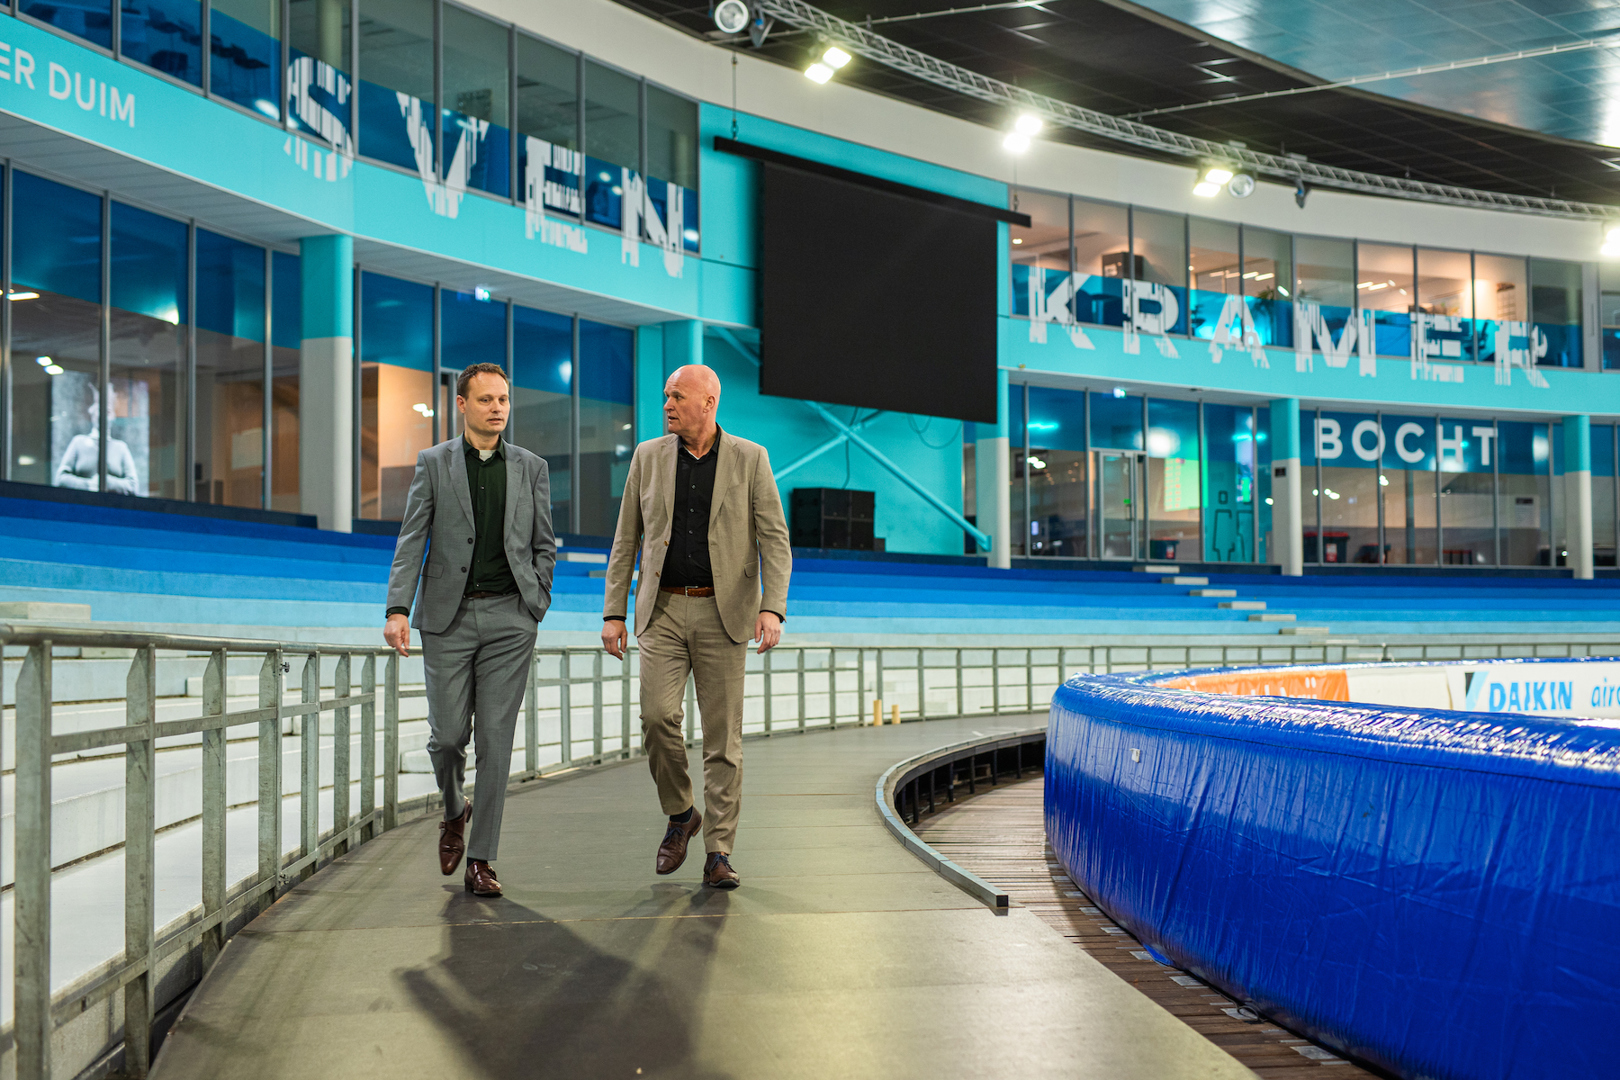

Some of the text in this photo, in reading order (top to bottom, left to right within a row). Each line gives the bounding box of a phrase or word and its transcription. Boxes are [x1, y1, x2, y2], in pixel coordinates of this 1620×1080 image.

[48, 61, 136, 129] DUIM
[283, 56, 1550, 389] SVEN KRAMER
[1314, 418, 1499, 466] BOCHT
[1489, 681, 1573, 712] DAIKIN
